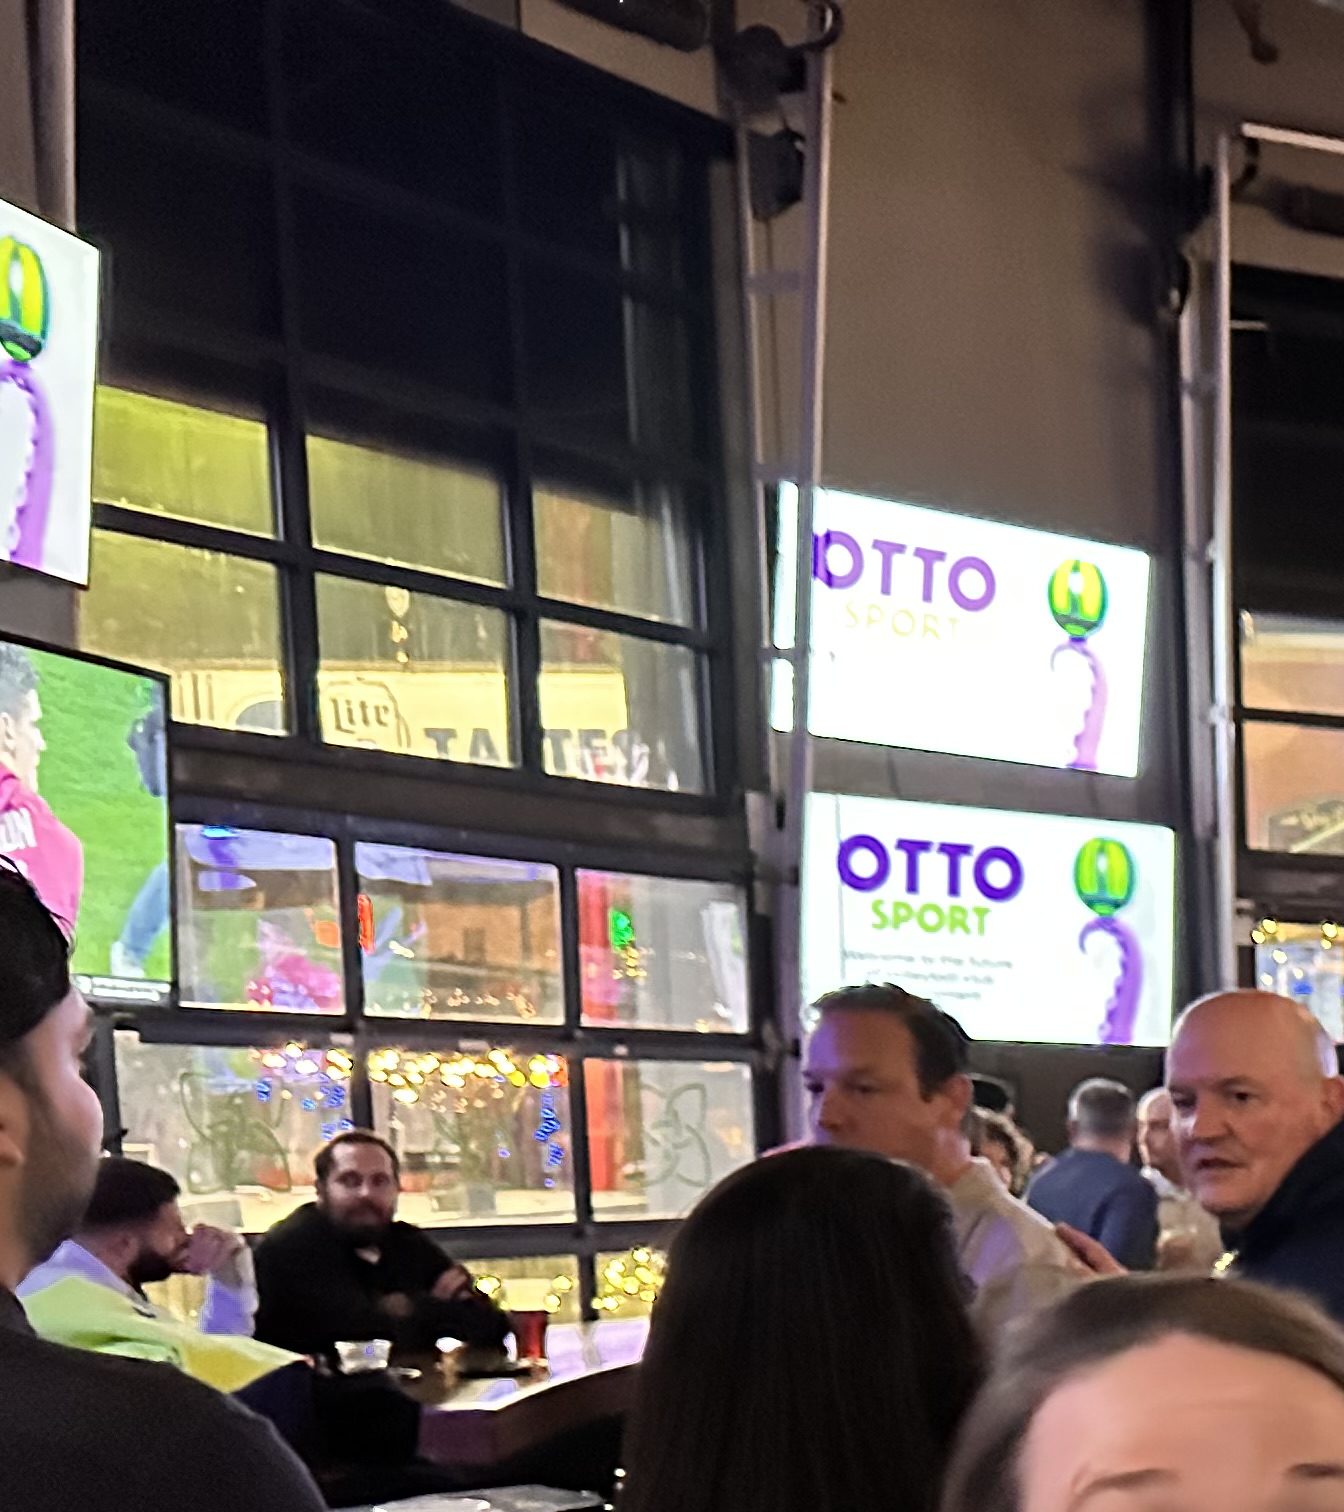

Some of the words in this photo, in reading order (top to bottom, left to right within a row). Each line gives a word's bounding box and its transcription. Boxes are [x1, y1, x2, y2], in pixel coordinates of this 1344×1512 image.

[812, 529, 996, 612] OTTO
[837, 834, 1024, 902] OTTO
[871, 899, 990, 935] SPORT
